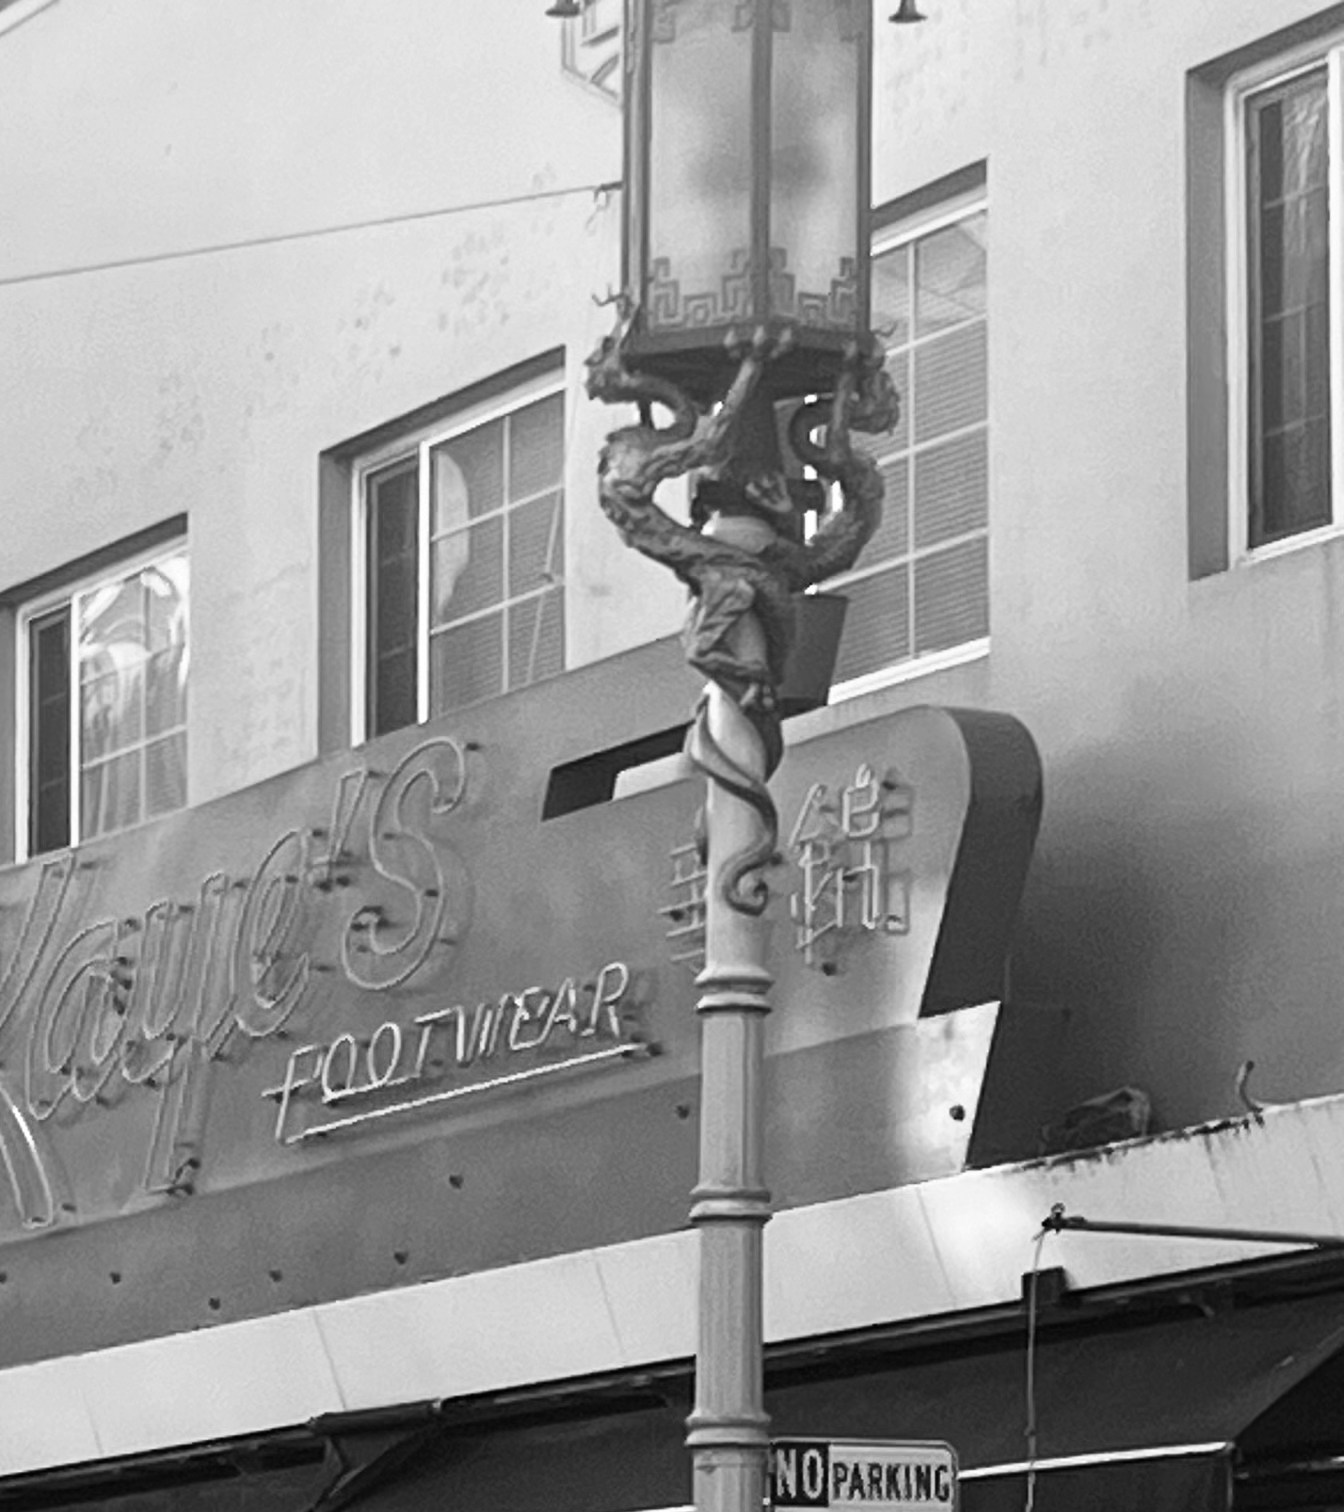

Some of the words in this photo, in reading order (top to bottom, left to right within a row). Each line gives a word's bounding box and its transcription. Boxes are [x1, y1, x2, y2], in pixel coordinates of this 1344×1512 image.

[262, 962, 630, 1144] FOOTWEAR
[776, 1448, 825, 1499] NO
[832, 1461, 951, 1503] PARKING
